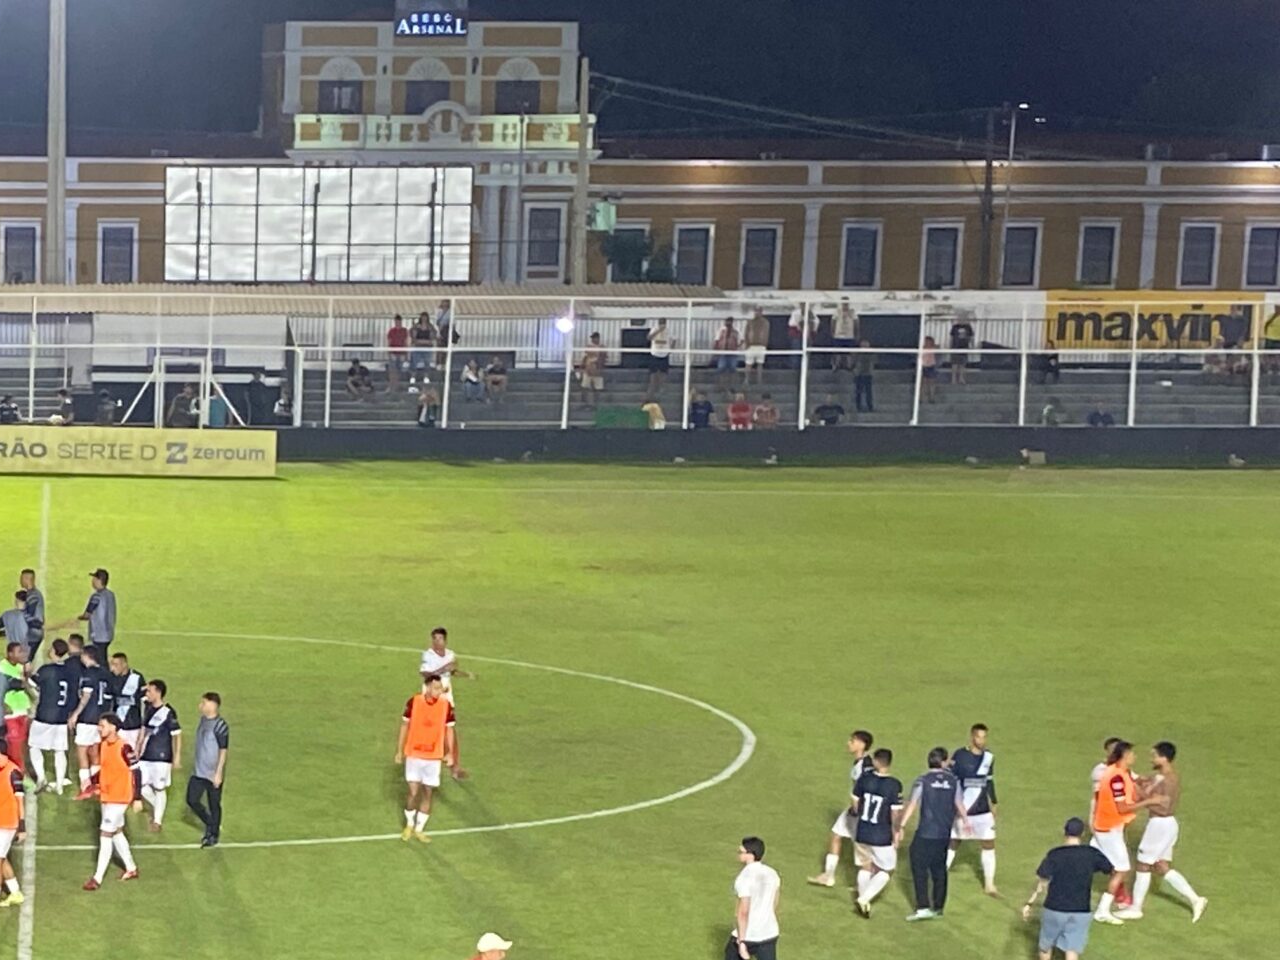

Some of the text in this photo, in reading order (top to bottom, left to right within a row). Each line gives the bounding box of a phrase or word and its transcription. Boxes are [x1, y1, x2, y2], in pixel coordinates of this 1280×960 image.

[1056, 303, 1253, 341] maxvinl
[140, 444, 157, 461] D
[192, 444, 266, 462] zeroum
[57, 681, 68, 706] 3
[860, 793, 884, 824] 17
